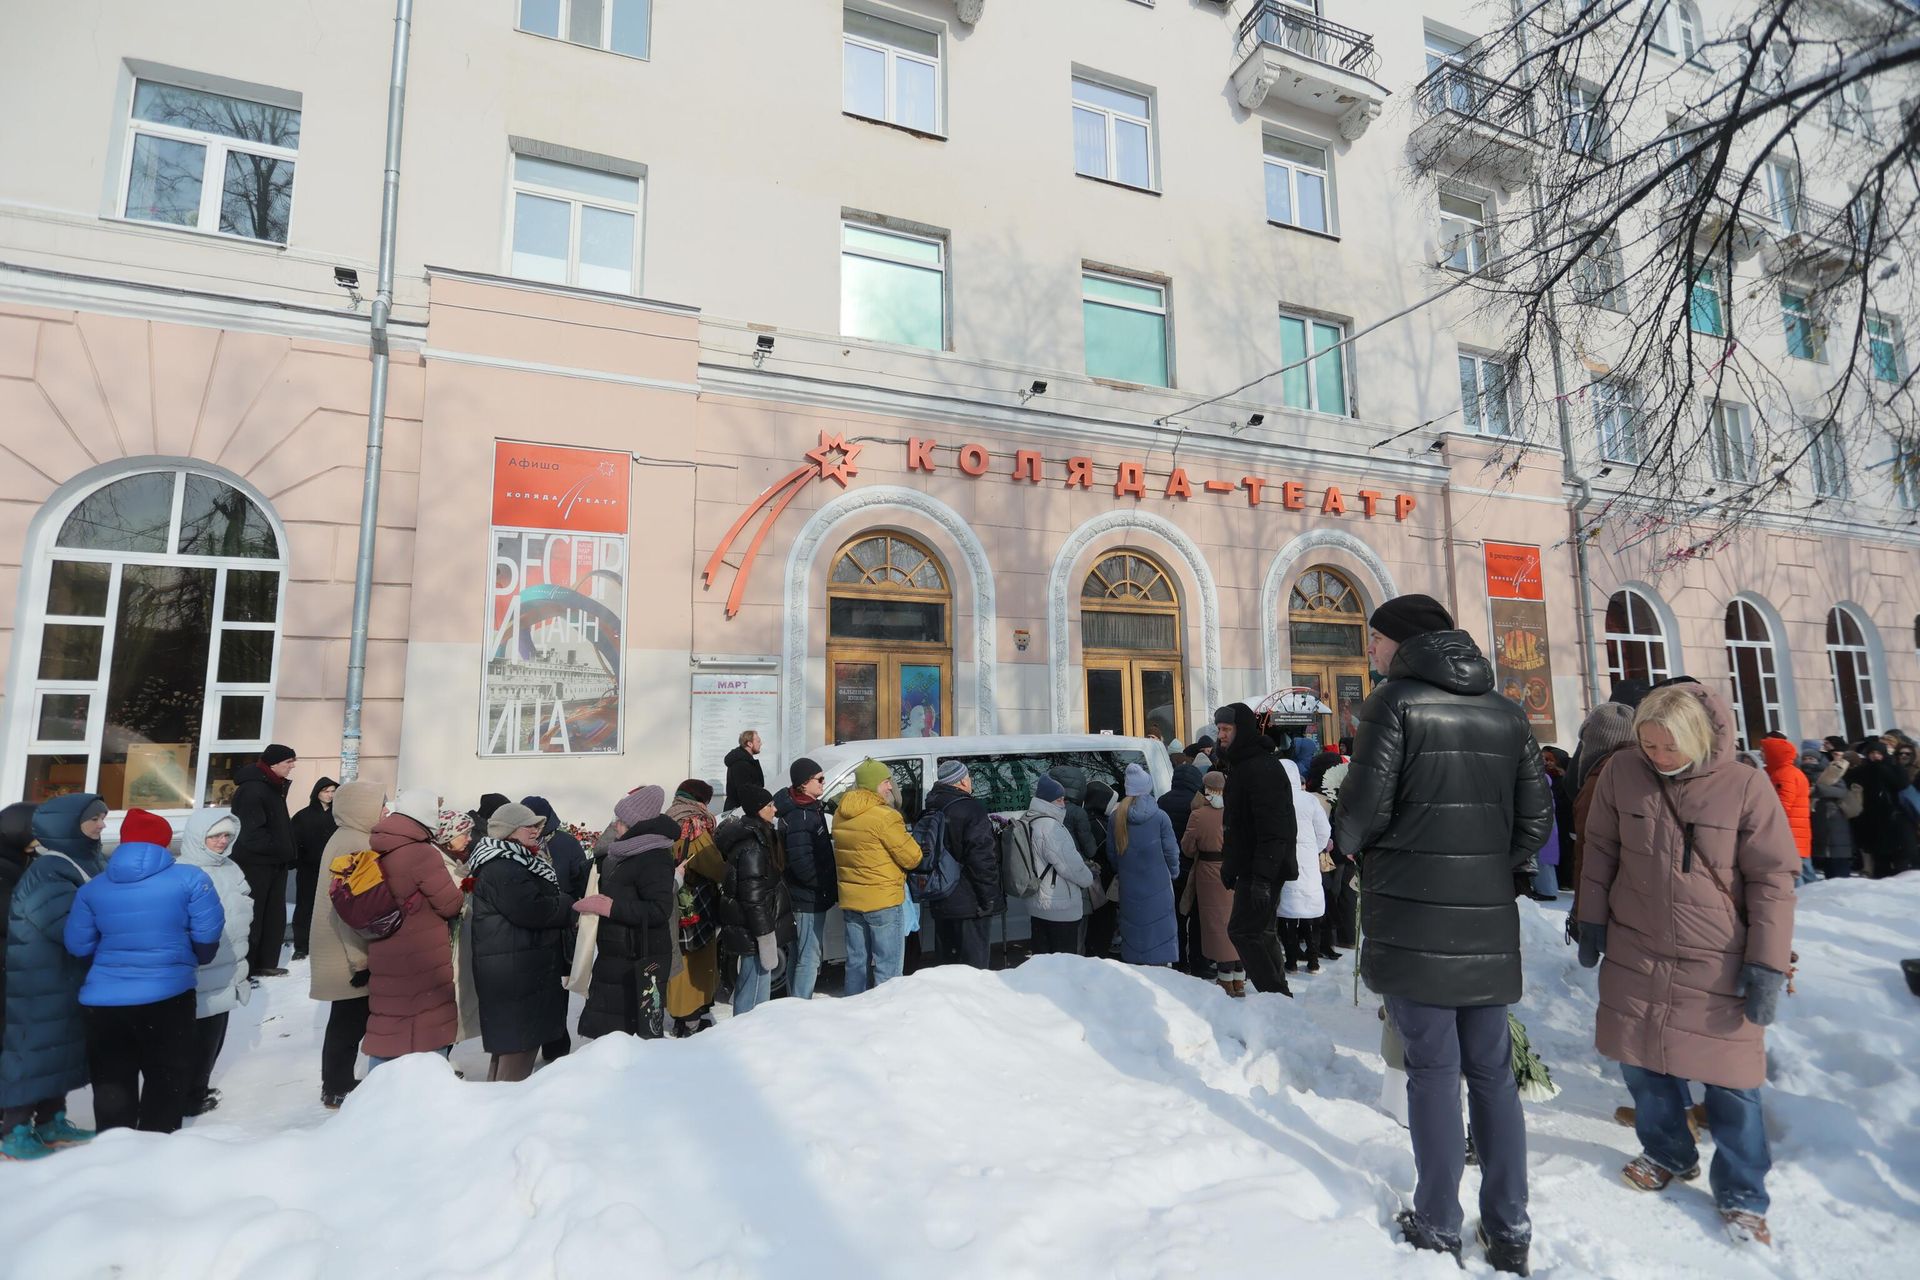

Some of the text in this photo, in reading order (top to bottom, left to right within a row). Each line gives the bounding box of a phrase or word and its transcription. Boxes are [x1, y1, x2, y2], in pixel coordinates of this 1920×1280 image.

[508, 457, 560, 471] Афиша
[506, 491, 617, 505] КОЛЯДА ТЕАТР
[1504, 630, 1538, 661] КАК
[717, 681, 749, 689] МАРТ
